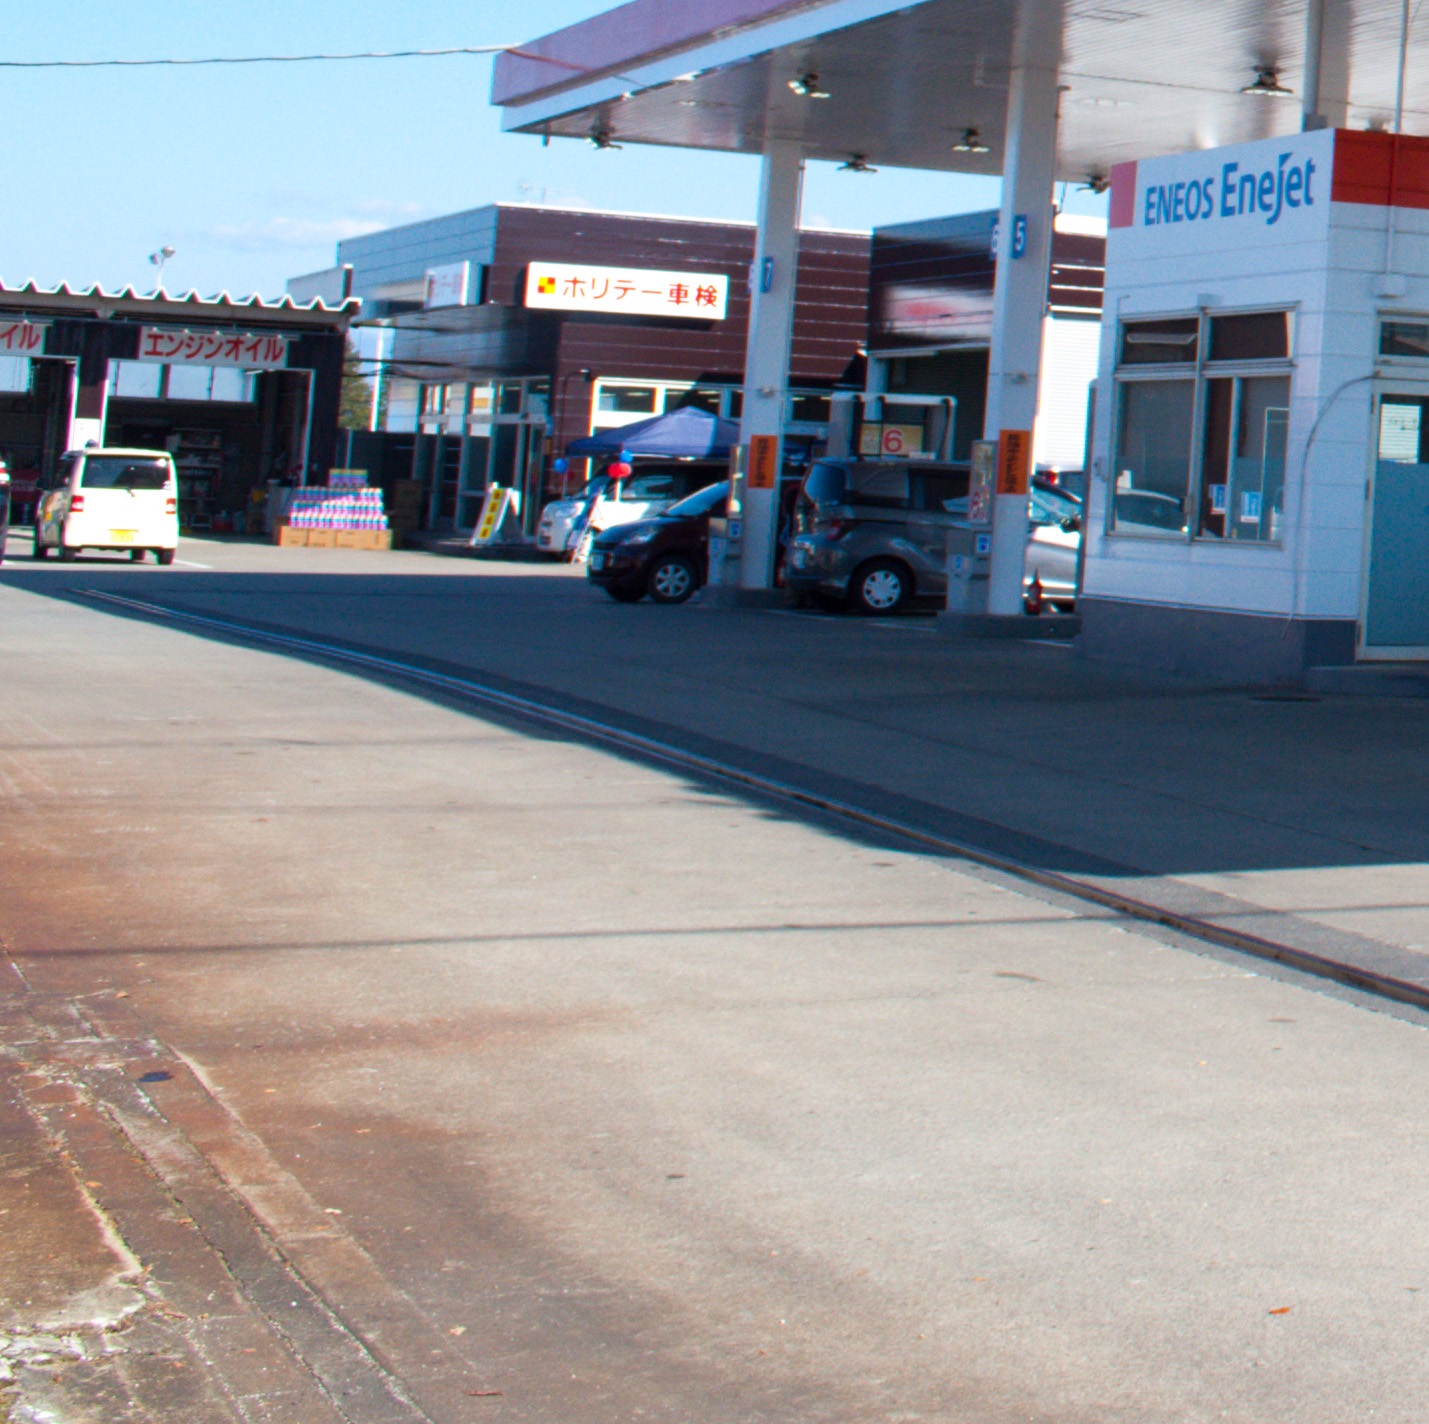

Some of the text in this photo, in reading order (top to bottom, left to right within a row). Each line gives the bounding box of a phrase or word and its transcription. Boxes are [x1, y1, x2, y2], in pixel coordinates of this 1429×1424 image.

[1144, 151, 1316, 226] ENEOS Enejet
[1014, 221, 1026, 251] 5
[143, 332, 286, 362] エンジンオイル
[883, 429, 903, 453] 6
